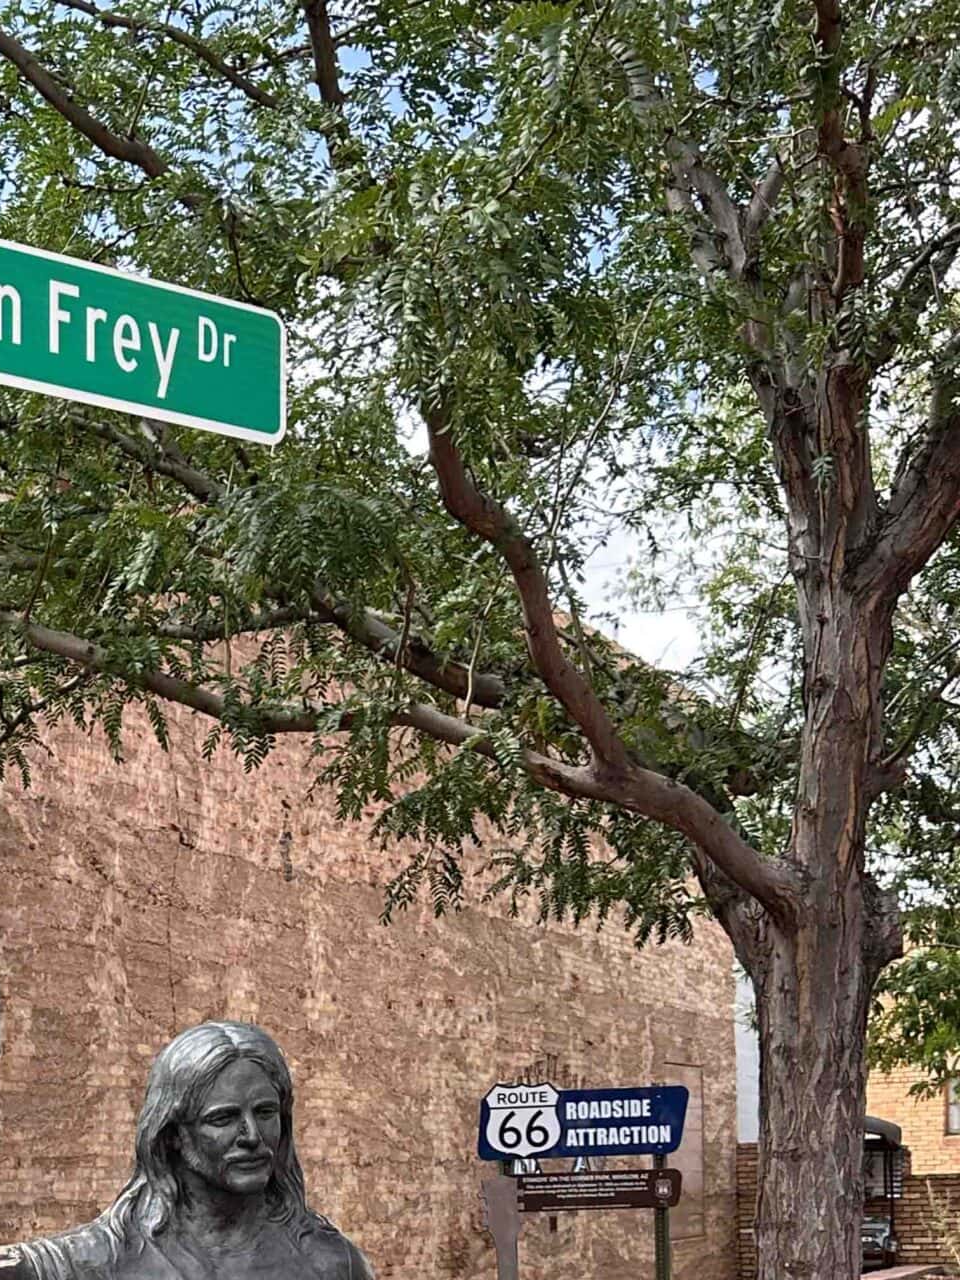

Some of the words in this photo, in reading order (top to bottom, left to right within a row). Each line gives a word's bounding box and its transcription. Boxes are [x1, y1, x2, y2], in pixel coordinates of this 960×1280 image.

[49, 280, 180, 399] Frey
[198, 316, 237, 367] Dr
[497, 1091, 549, 1105] ROUTE
[565, 1099, 651, 1120] ROADSIDE
[498, 1110, 549, 1148] 66
[565, 1125, 671, 1147] ATTRACTION
